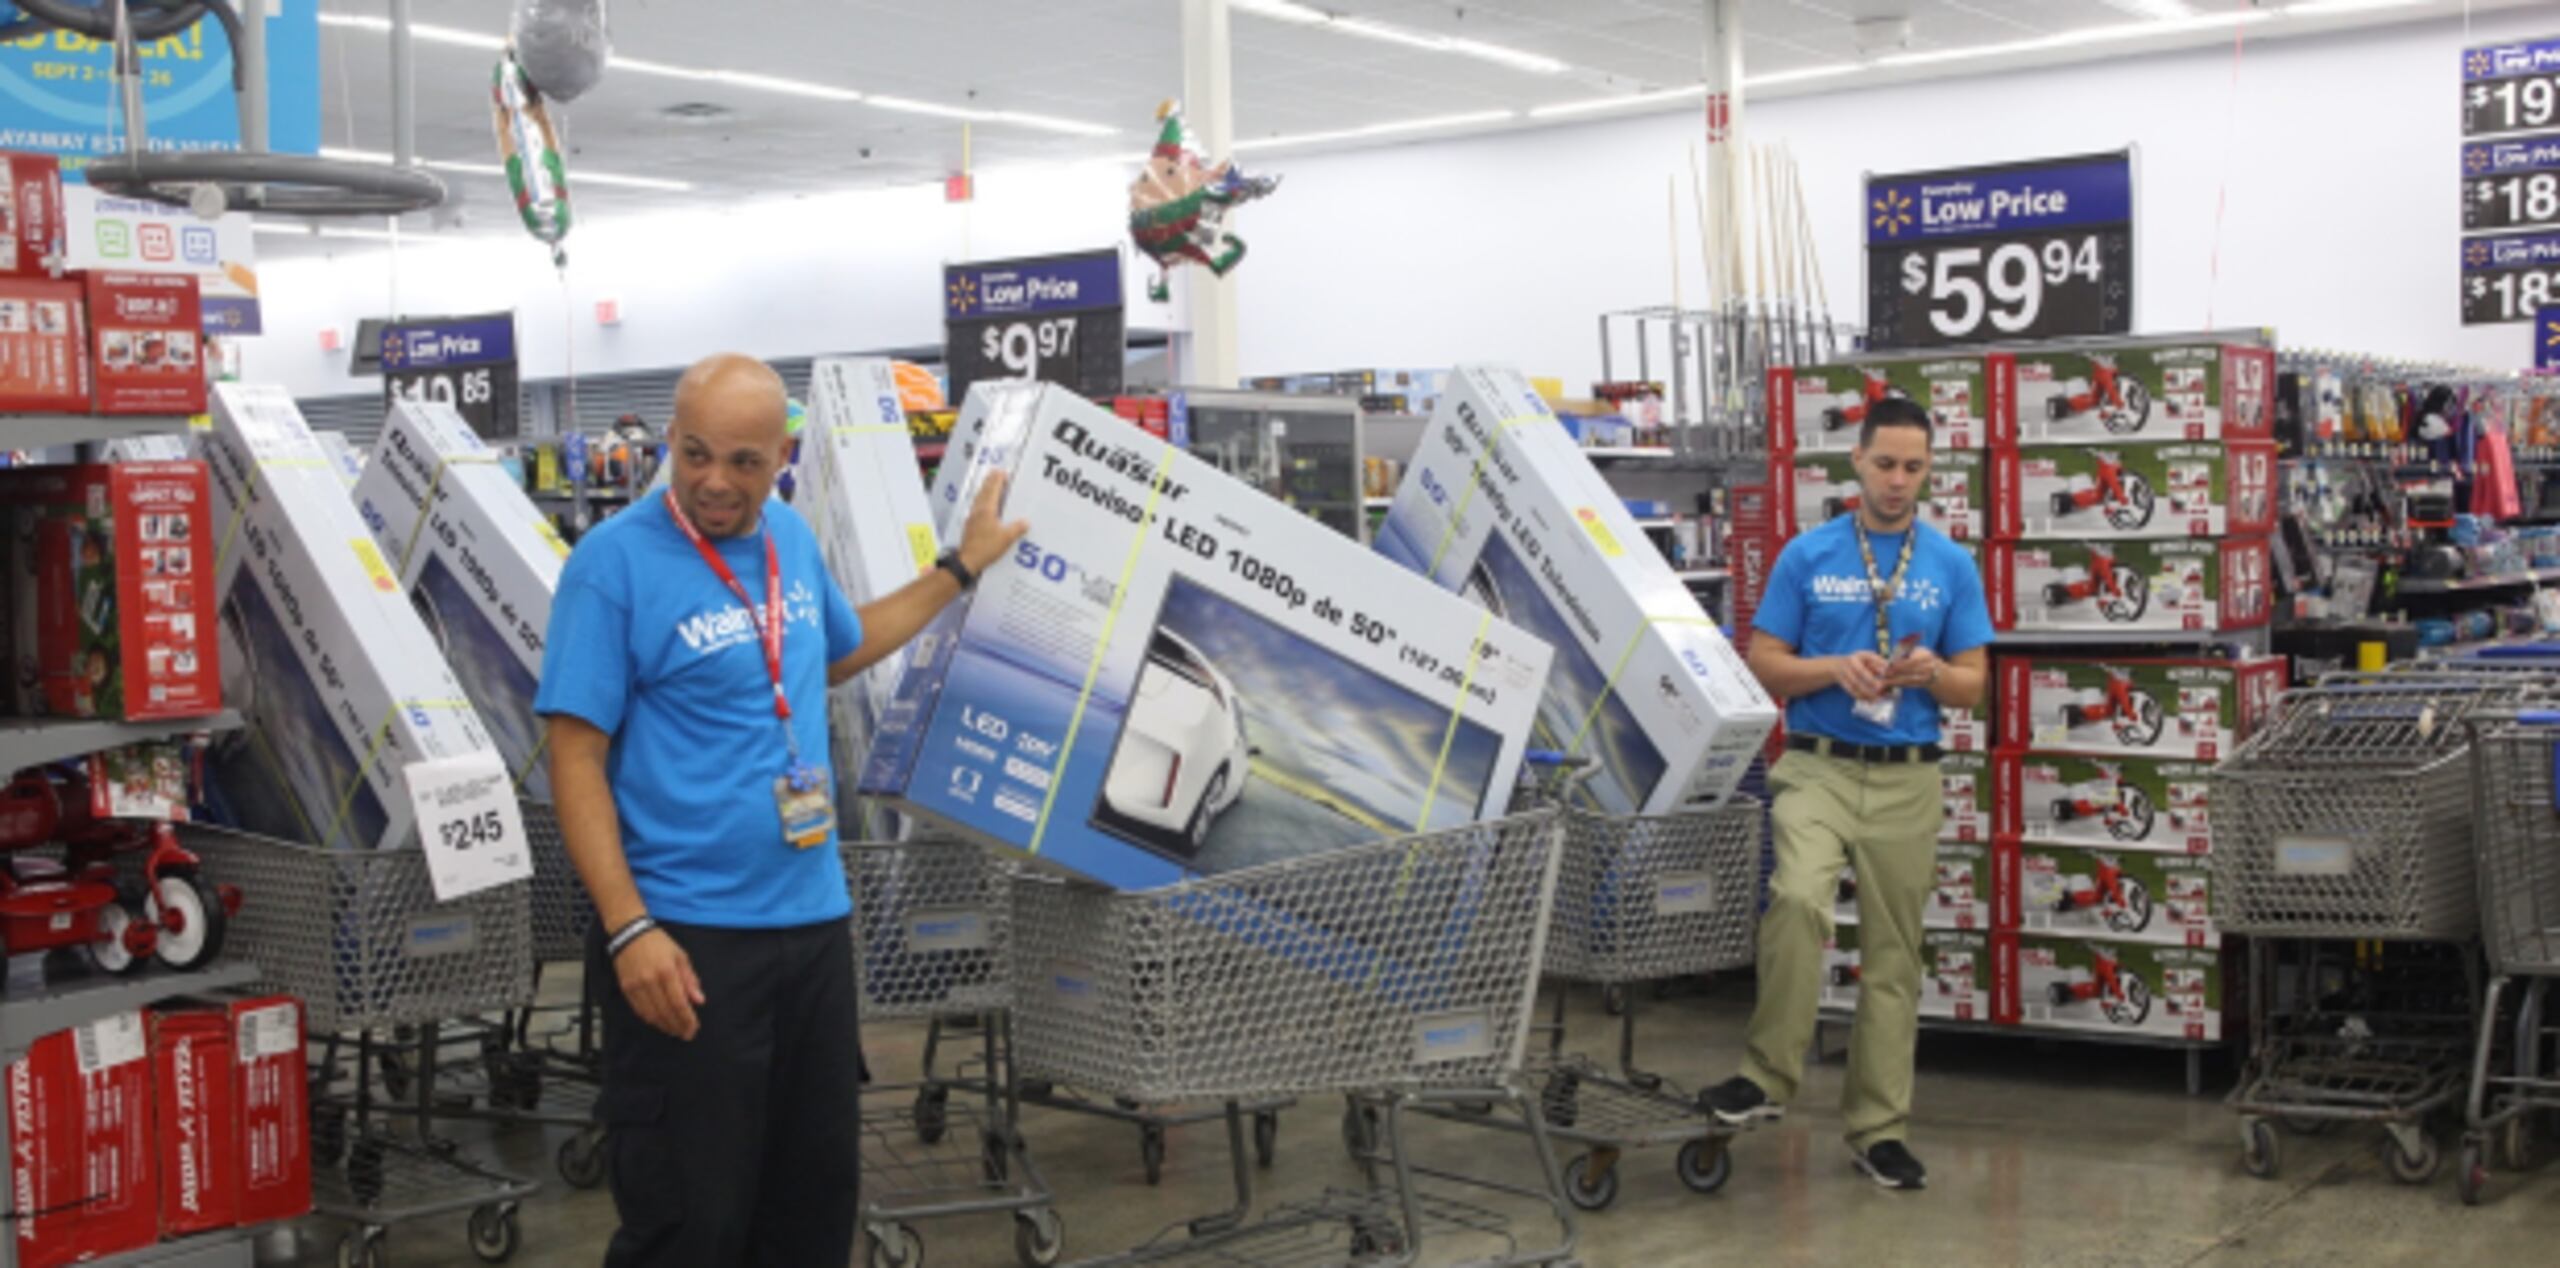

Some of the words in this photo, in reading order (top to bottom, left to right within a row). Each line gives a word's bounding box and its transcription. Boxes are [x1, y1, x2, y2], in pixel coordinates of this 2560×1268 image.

[1921, 198, 1985, 226] Low
[1988, 185, 2068, 218] Price
[981, 281, 1025, 306] Low
[1026, 275, 1080, 303] Price
[1052, 417, 1191, 501] Quasar
[1162, 517, 1219, 560] LED
[1227, 549, 1308, 601] 1080p
[1312, 596, 1344, 626] de
[1813, 575, 1908, 601] Walmt
[677, 600, 796, 649] Walmat
[961, 704, 1009, 742] LED
[438, 809, 503, 851] $245
